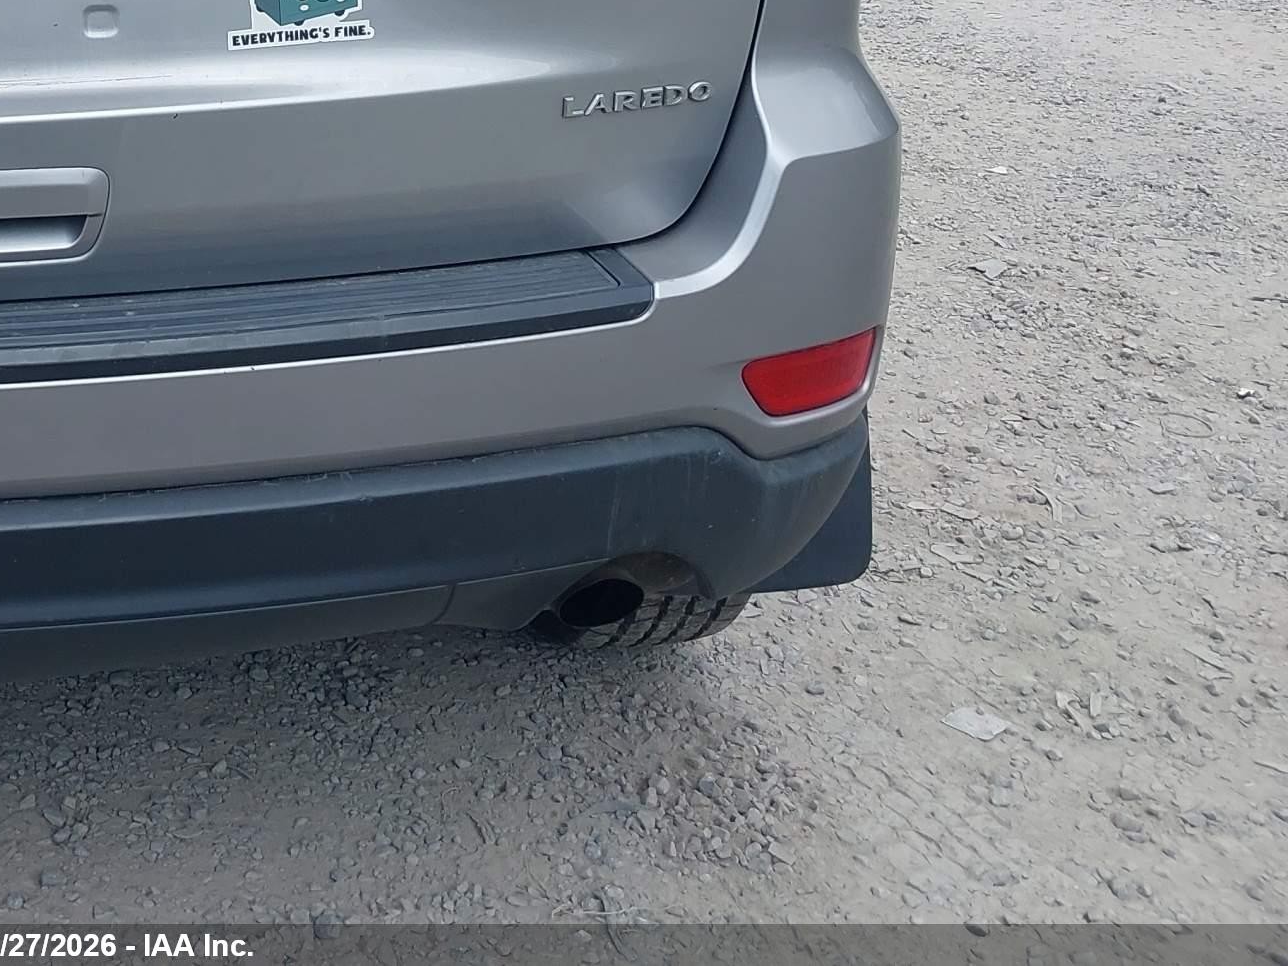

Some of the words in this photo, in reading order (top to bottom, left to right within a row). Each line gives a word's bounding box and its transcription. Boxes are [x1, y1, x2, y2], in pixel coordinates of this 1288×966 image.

[232, 27, 330, 46] EVERYTHING'S
[334, 25, 371, 37] FINE.
[562, 81, 713, 118] LAREDO
